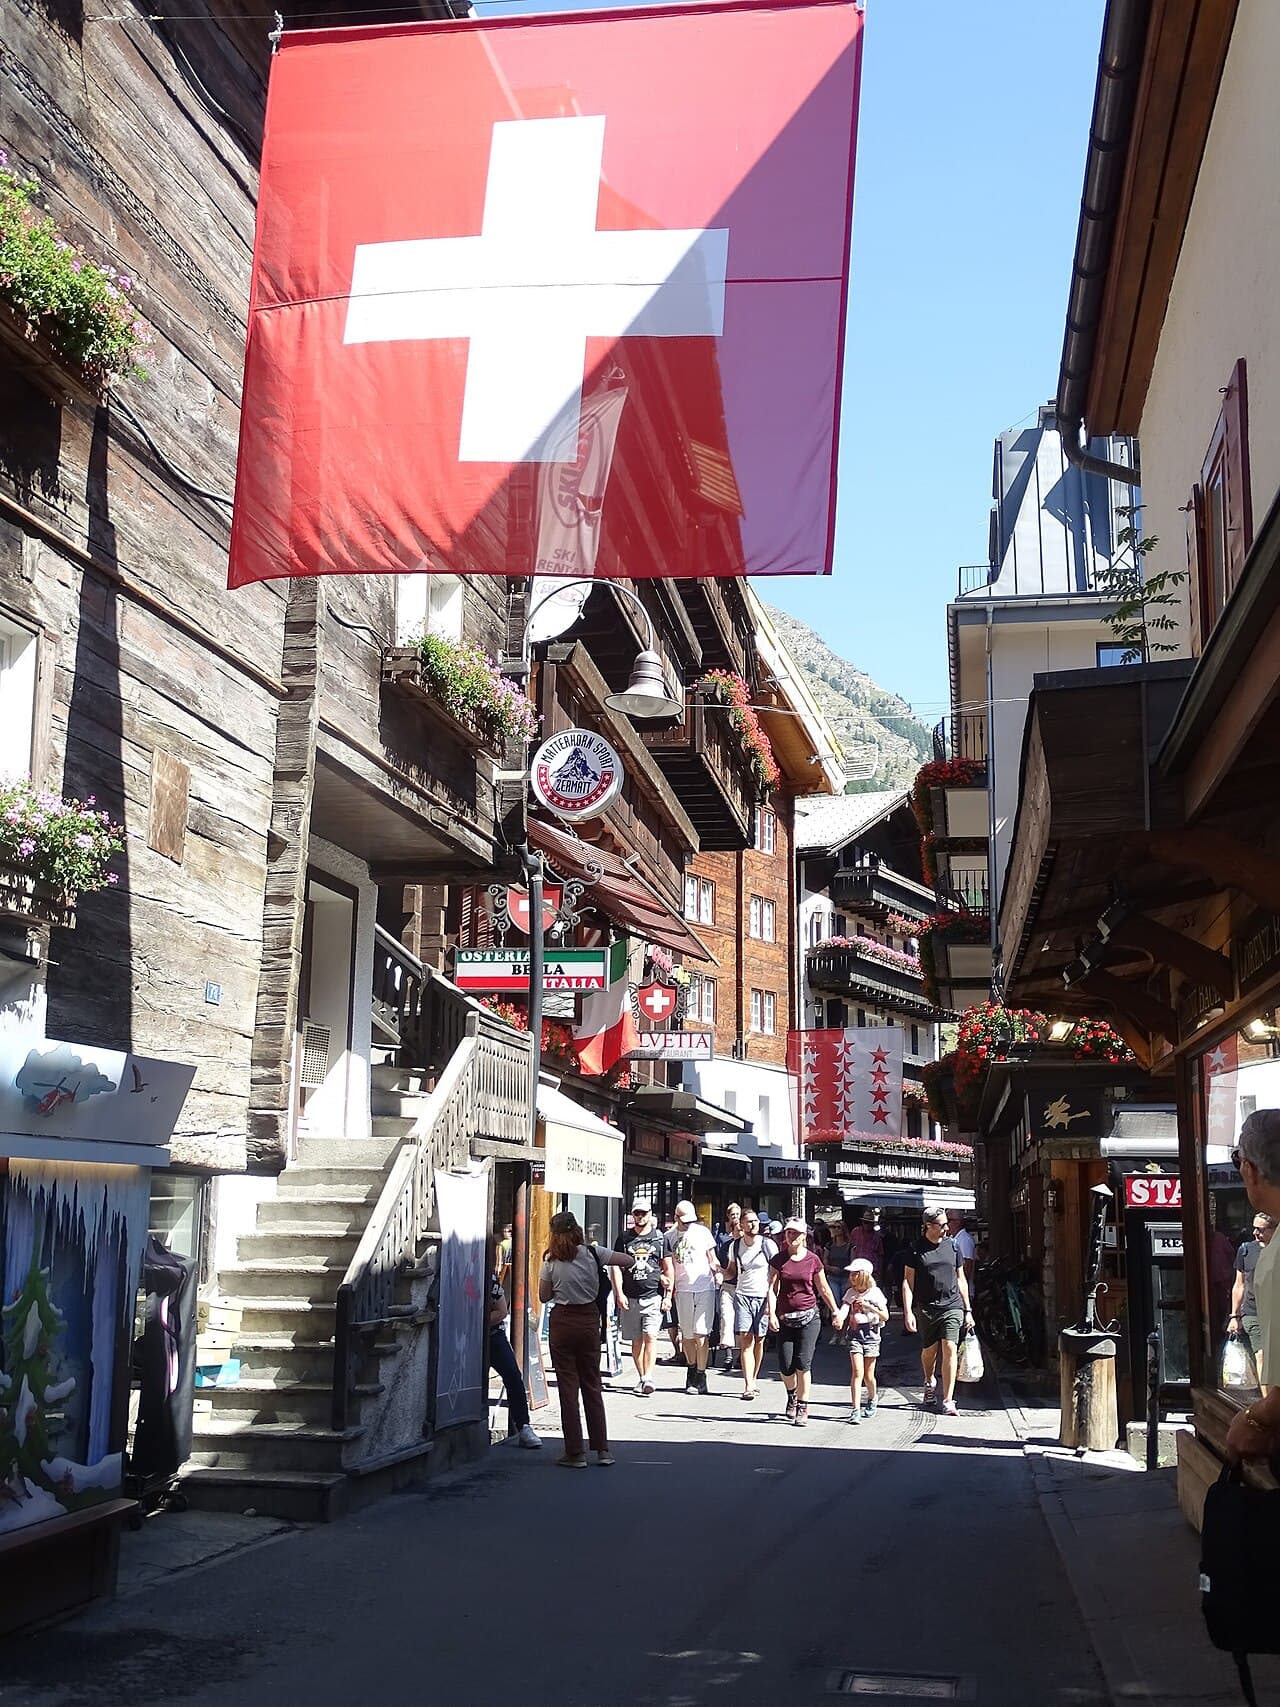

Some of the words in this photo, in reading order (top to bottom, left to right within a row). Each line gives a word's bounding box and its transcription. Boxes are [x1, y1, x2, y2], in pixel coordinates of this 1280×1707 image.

[553, 549, 576, 562] SKI
[541, 734, 594, 764] MATTERHORN
[593, 742, 614, 769] SPORT
[556, 779, 592, 793] ZERMATT
[461, 951, 530, 962] OSTERIA
[512, 964, 565, 975] BELA
[543, 978, 599, 989] ITALIA
[639, 1033, 710, 1049] LVETIA
[649, 1049, 693, 1058] RESTAURANT
